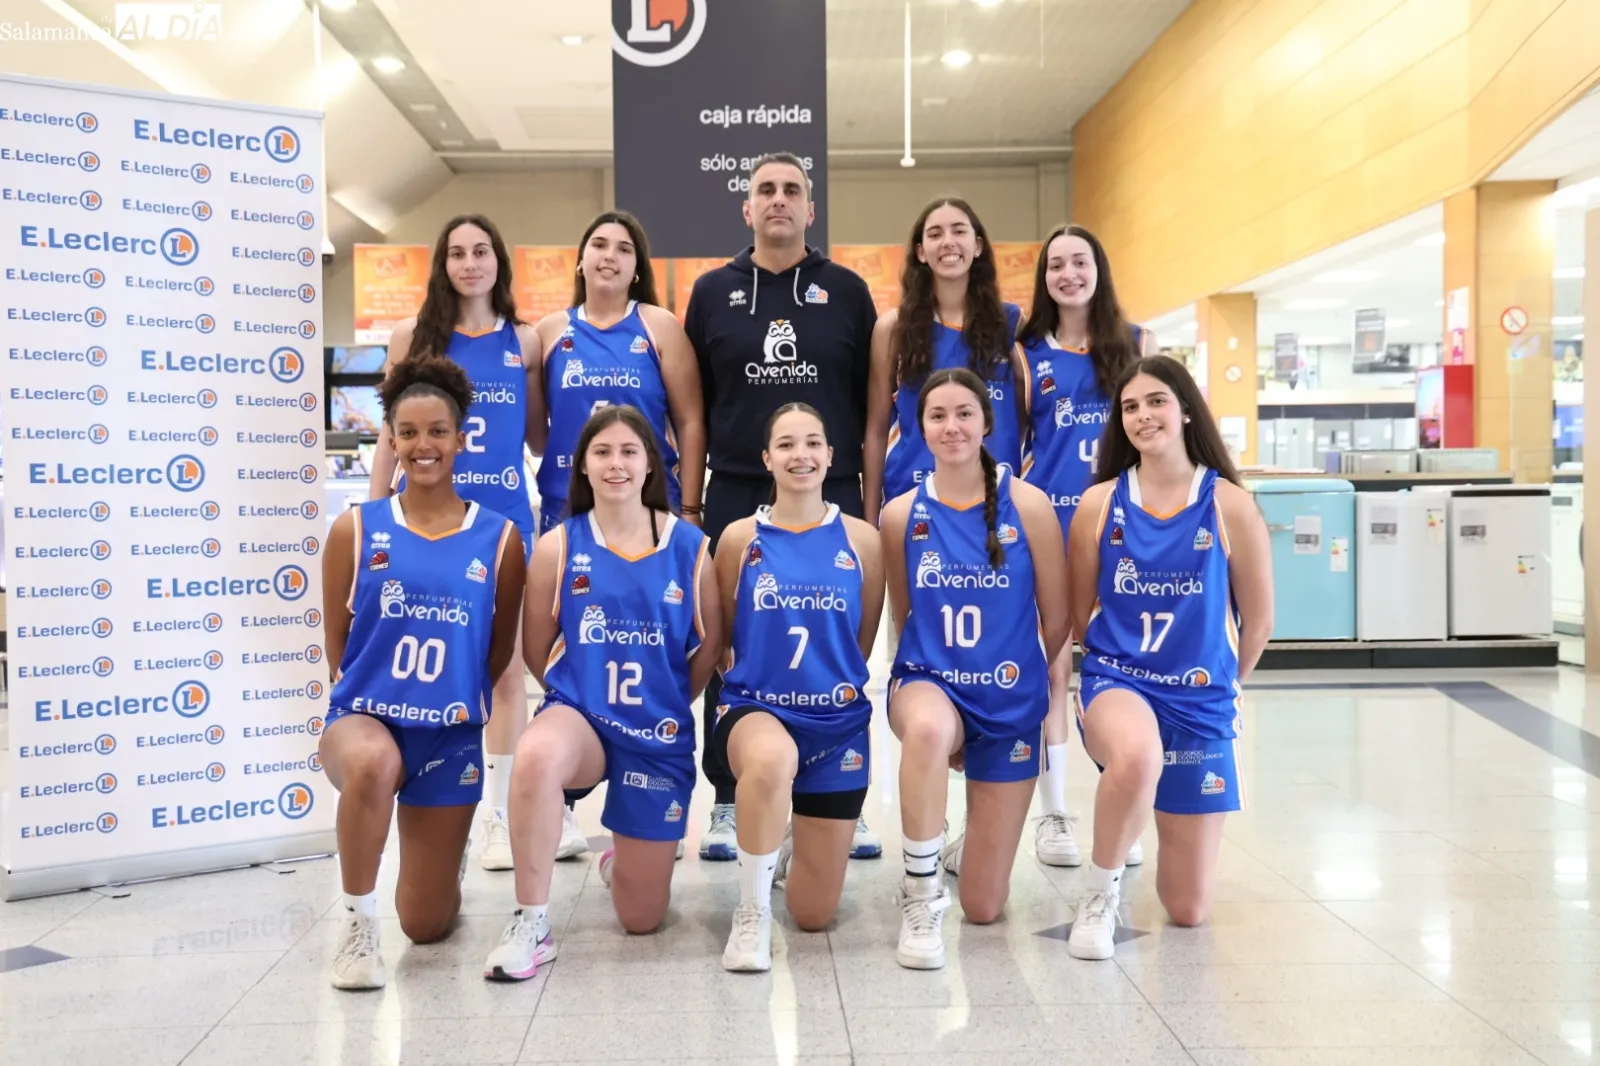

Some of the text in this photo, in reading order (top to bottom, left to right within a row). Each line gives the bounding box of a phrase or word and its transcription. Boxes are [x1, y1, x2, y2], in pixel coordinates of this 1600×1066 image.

[0, 108, 74, 127] E.Leclerc
[699, 104, 812, 128] caja rápida
[134, 119, 261, 152] E.Leclerc
[1, 148, 76, 166] E.Leclerc
[700, 153, 737, 171] sólo
[121, 160, 188, 178] E.Leclerc
[230, 172, 294, 188] E.Leclerc
[3, 188, 77, 206] E.Leclerc
[123, 199, 190, 215] E.Leclerc
[231, 209, 295, 224] E.Leclerc
[21, 226, 156, 255] E.Leclerc
[232, 247, 295, 261] E.Leclerc
[6, 268, 81, 283] E.Leclerc
[126, 276, 192, 291] E.Leclerc
[233, 284, 296, 298] E.Leclerc
[8, 308, 82, 322] E.Leclerc
[126, 315, 193, 329] E.Leclerc
[234, 321, 296, 334] E.Leclerc
[9, 348, 84, 362] E.Leclerc
[141, 350, 265, 374] E.Leclerc
[745, 361, 818, 378] avenida
[568, 371, 641, 389] avenida
[748, 376, 818, 385] PERFUMERÍAS
[10, 388, 85, 400] E.Leclerc
[127, 392, 195, 404] E.Leclerc
[236, 395, 297, 407] E.Leclerc
[12, 428, 86, 440] E.Leclerc
[129, 430, 196, 442] E.Leclerc
[237, 432, 298, 443] E.Leclerc
[1078, 438, 1099, 473] 4
[29, 463, 162, 484] E.Leclerc
[238, 469, 298, 480] E.Leclerc
[14, 507, 87, 518] E.Leclerc
[130, 506, 198, 517] E.Leclerc
[239, 506, 299, 516] E.Leclerc
[15, 546, 88, 558] E.Leclerc
[131, 544, 199, 555] E.Leclerc
[240, 542, 300, 553] E.Leclerc
[923, 569, 1010, 589] avenida
[1120, 577, 1203, 596] avenida
[16, 586, 89, 598] E.Leclerc
[147, 577, 270, 598] E.Leclerc
[778, 584, 847, 594] PERFUMERÍAS
[760, 592, 847, 612] avenida
[386, 599, 469, 626] avenida
[133, 620, 201, 632] E.Leclerc
[241, 615, 302, 627] E.Leclerc
[940, 604, 982, 648] 10
[18, 625, 90, 638] E.Leclerc
[1139, 611, 1175, 653] 17
[787, 626, 810, 670] 7
[134, 658, 202, 670] E.Leclerc
[242, 652, 303, 664] E.Leclerc
[391, 635, 446, 683] 00
[19, 665, 90, 678] E.Leclerc
[605, 660, 643, 705] 12
[243, 688, 304, 701] E.Leclerc
[35, 696, 168, 722] E.Leclerc
[352, 697, 441, 723] E.Leclerc
[243, 725, 305, 738] E.Leclerc
[137, 733, 203, 747] E.Leclerc
[20, 743, 92, 758] E.Leclerc
[244, 761, 306, 775] E.Leclerc
[137, 771, 204, 786] E.Leclerc
[20, 782, 94, 798] E.Leclerc
[151, 799, 276, 828] E.Leclerc
[21, 822, 94, 839] E.Leclerc
